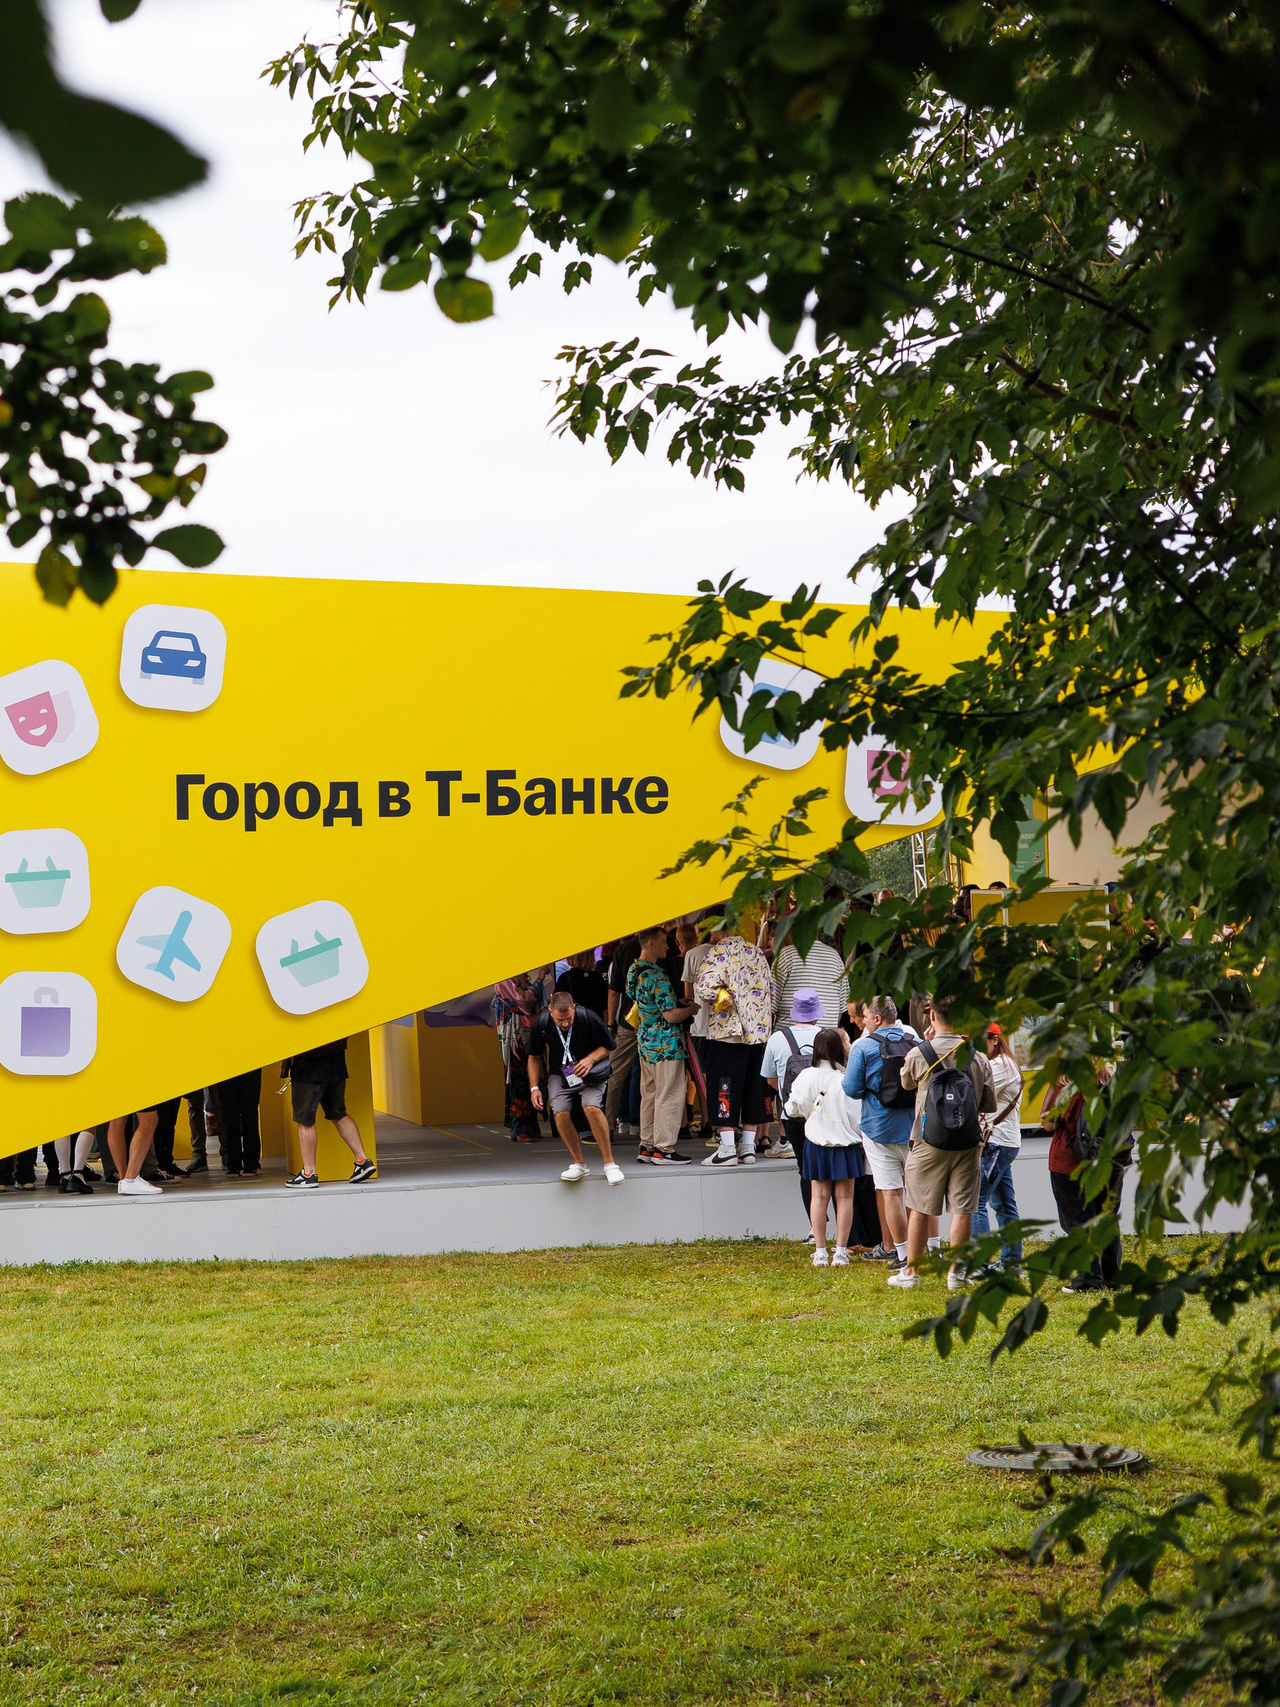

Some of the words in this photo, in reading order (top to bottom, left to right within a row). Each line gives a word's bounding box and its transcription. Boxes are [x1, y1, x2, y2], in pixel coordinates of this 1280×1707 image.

[176, 773, 362, 831] Город
[378, 780, 411, 817] в
[426, 769, 669, 816] Т-Банке
